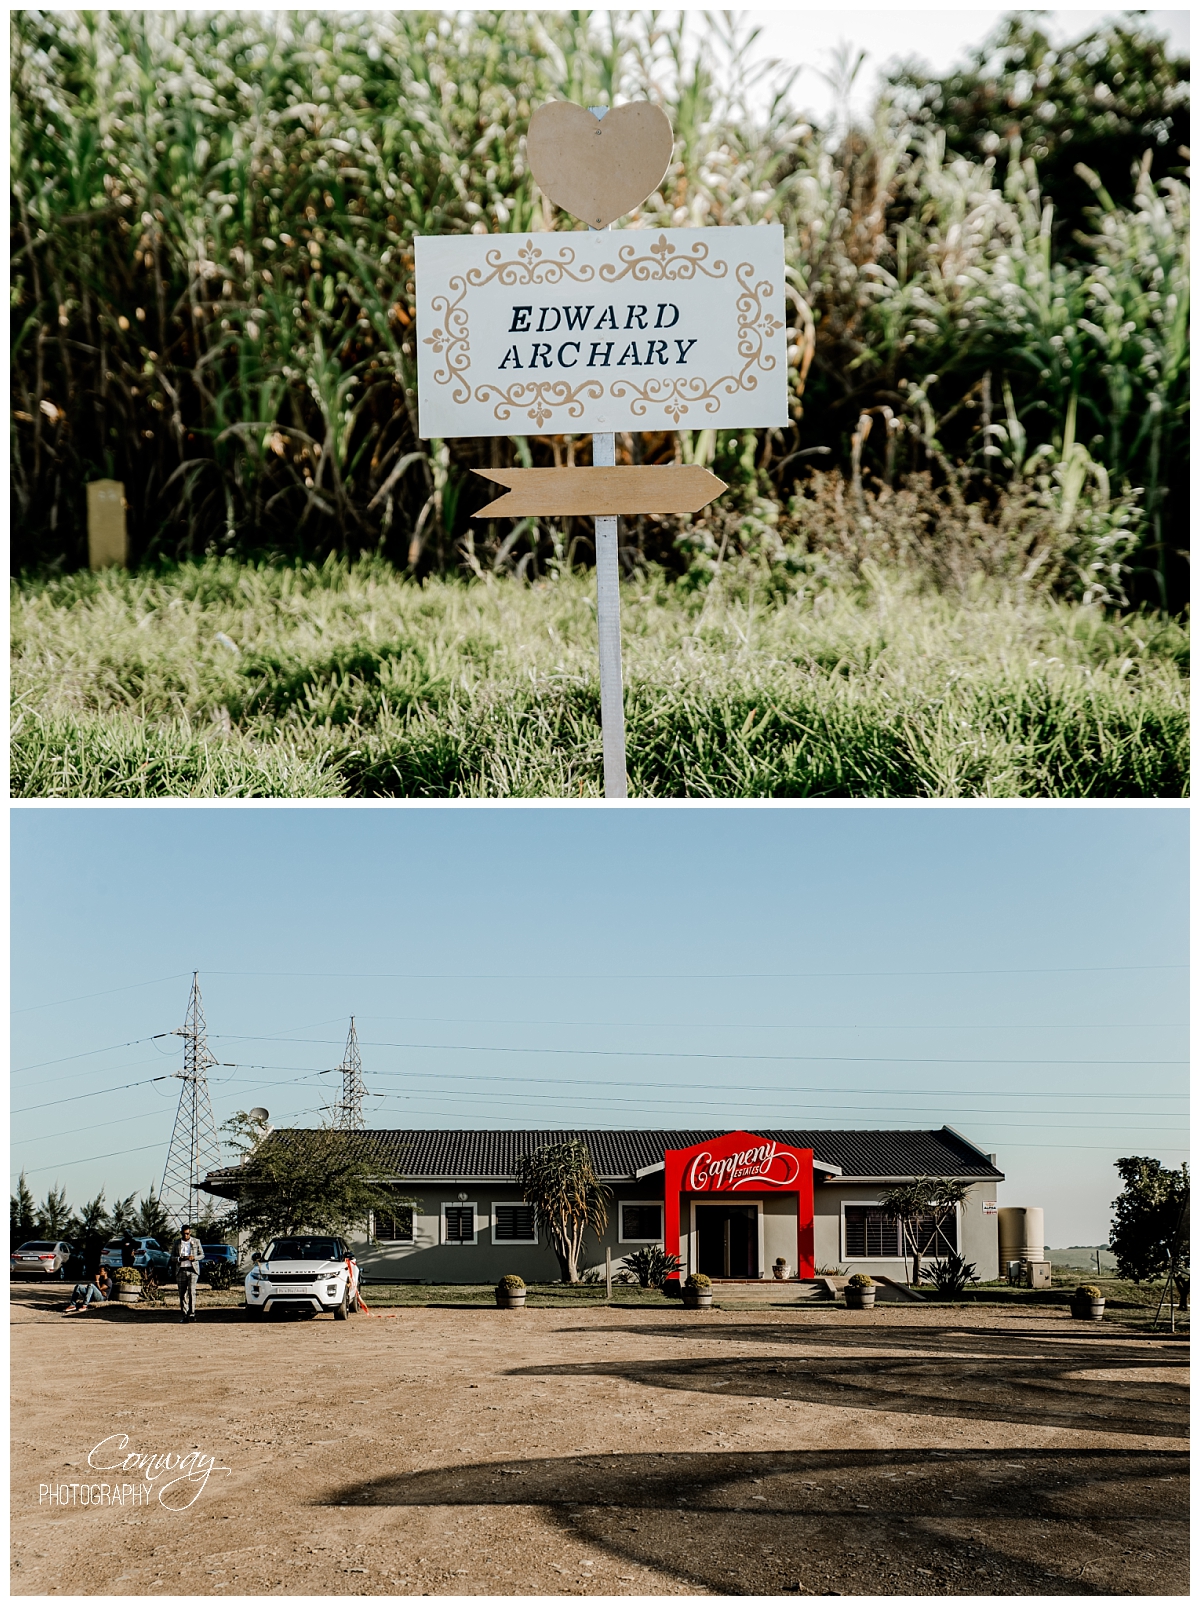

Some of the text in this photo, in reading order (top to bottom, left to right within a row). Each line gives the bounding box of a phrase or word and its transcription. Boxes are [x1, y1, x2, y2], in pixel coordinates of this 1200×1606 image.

[508, 303, 680, 333] EDWARD
[498, 339, 698, 370] ARCHARY
[690, 1141, 799, 1190] Cappeny
[733, 1165, 760, 1178] ESTATES
